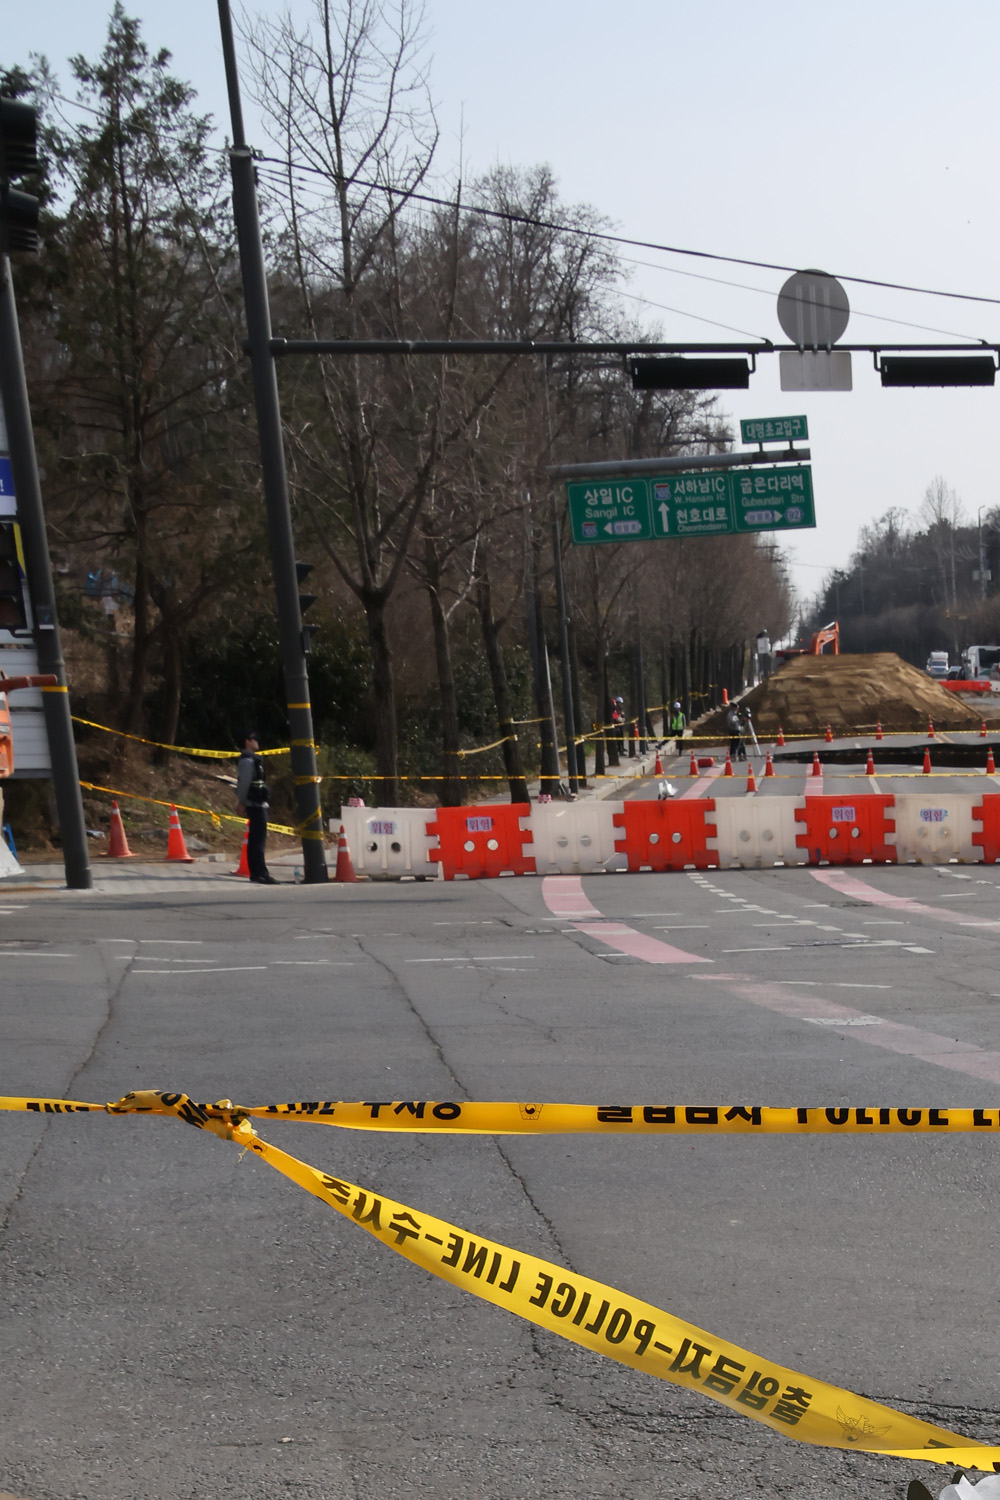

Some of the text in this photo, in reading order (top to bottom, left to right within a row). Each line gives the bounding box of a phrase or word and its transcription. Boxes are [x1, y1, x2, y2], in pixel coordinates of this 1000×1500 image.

[745, 418, 802, 439] 대명초교입구
[740, 474, 805, 495] 굽은다리역
[716, 492, 727, 502] IC
[585, 505, 635, 520] Sangil IC
[676, 507, 729, 525] 천호대로
[787, 509, 800, 519] 92
[833, 808, 855, 821] 위험
[921, 809, 945, 822] 위험
[371, 821, 394, 835] 위험
[468, 818, 490, 831] 위험
